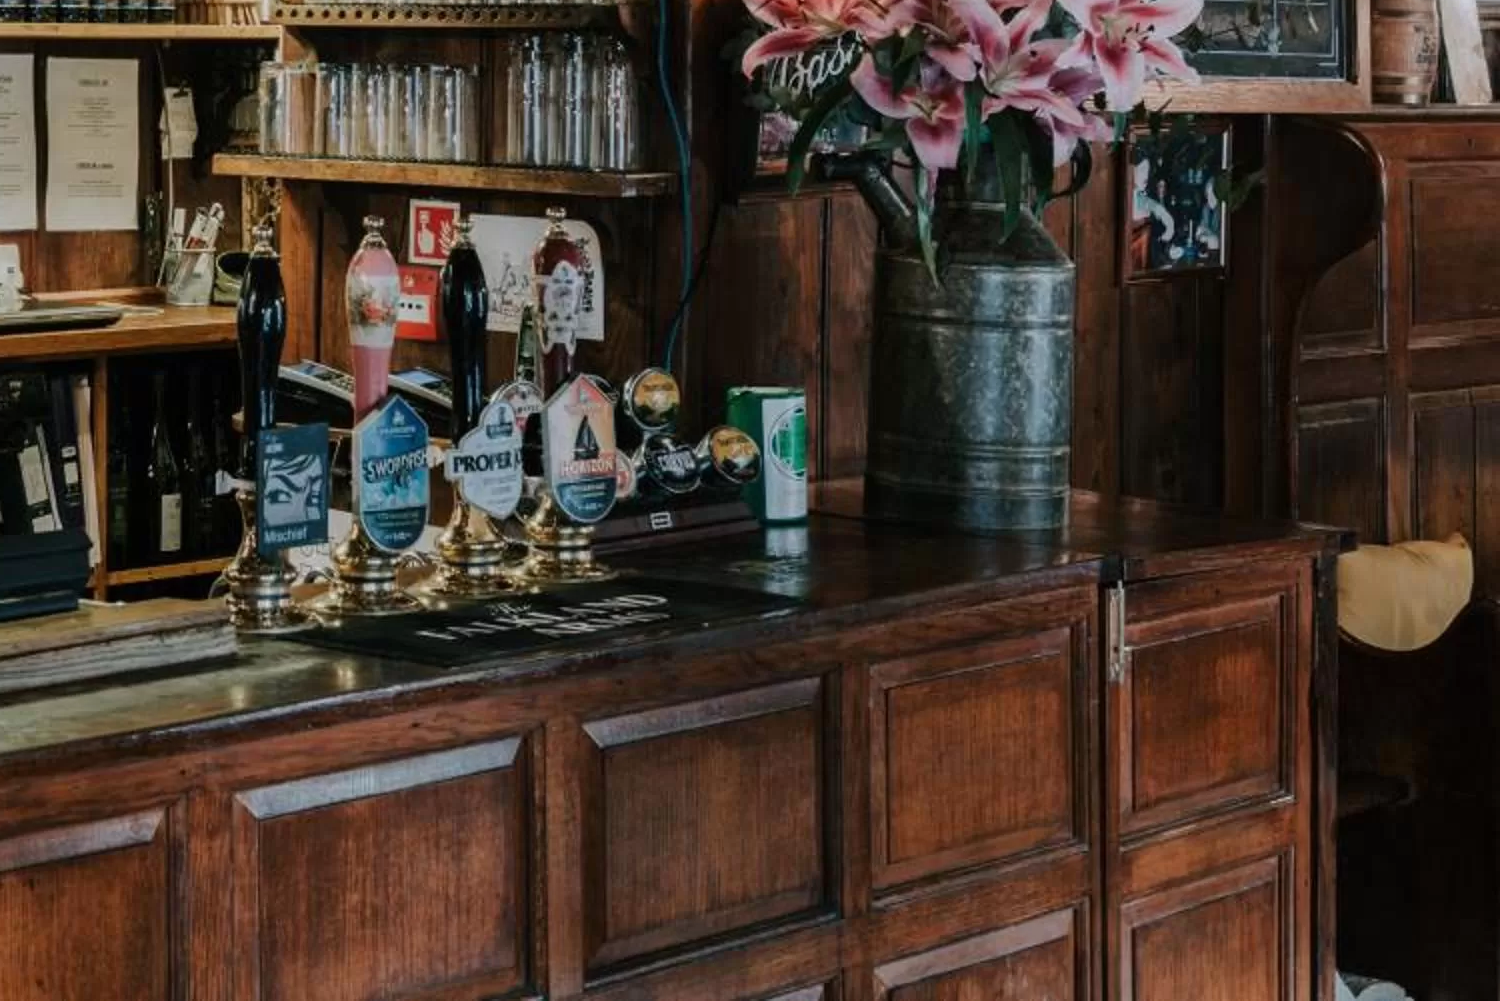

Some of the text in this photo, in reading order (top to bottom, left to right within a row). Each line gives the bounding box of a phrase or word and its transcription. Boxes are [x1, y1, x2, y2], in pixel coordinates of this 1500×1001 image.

[365, 449, 429, 483] SWORDFISH
[453, 450, 512, 474] PROPER
[560, 458, 615, 477] HORIZON
[263, 525, 307, 544] Mischief
